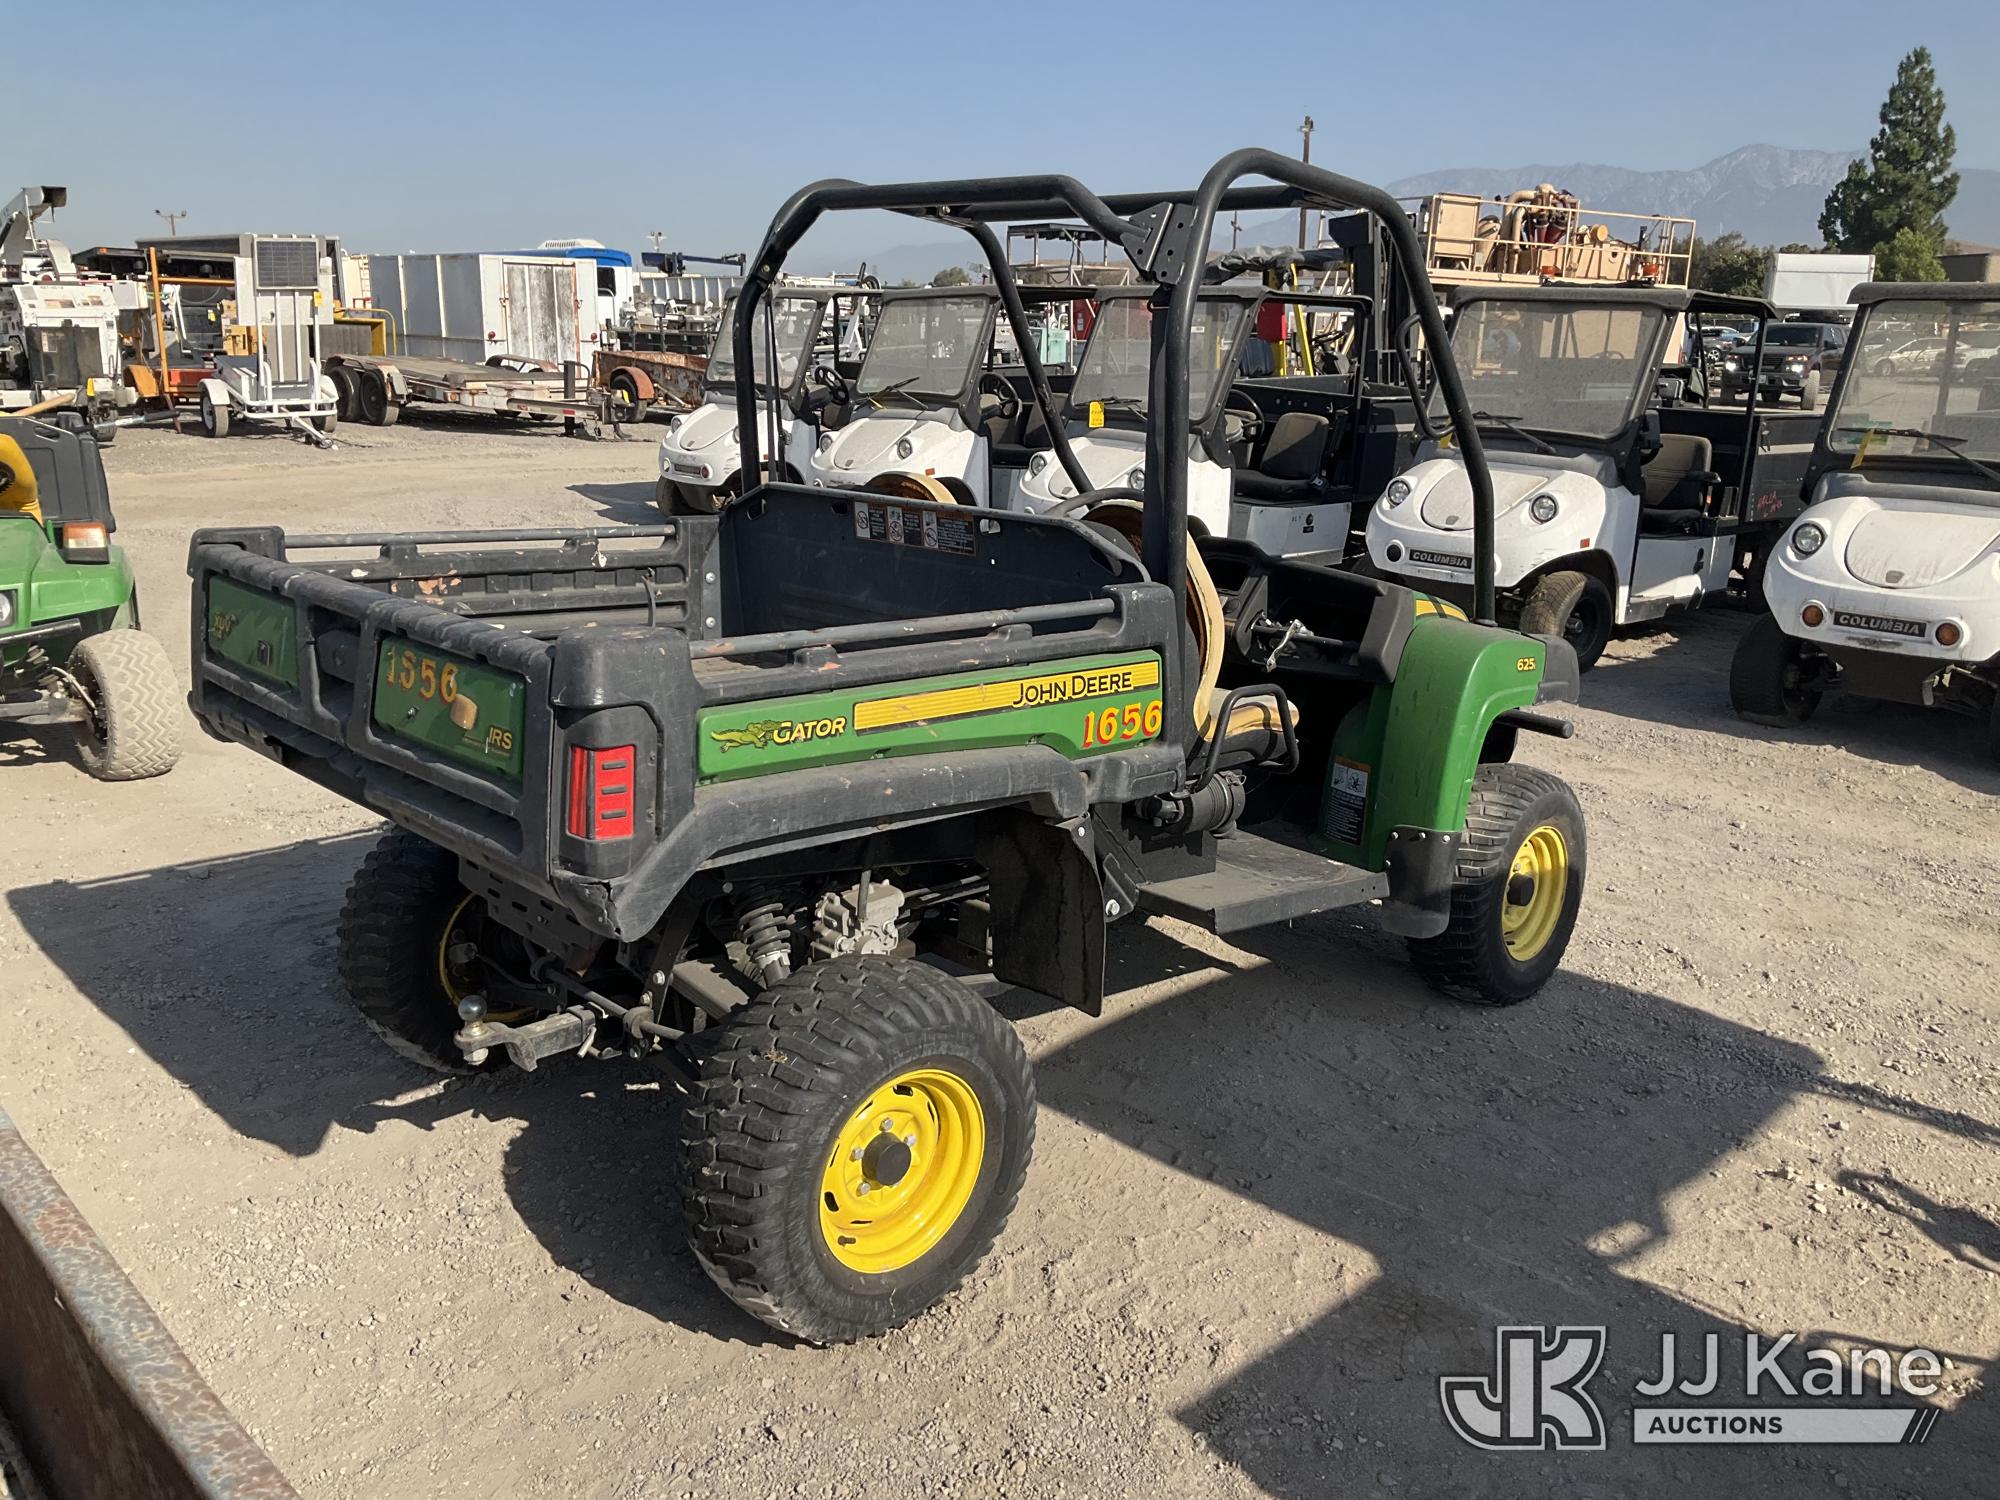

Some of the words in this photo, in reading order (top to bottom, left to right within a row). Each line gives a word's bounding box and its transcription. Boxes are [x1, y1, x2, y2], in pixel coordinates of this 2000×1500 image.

[1412, 551, 1469, 567] COLUMBIA
[1839, 614, 1920, 635] COLUMBIA
[1012, 682, 1067, 706] JOHN
[1071, 671, 1133, 696] DEERE
[772, 716, 847, 745] GATOR
[1081, 700, 1163, 749] 1656
[488, 726, 513, 751] IRS
